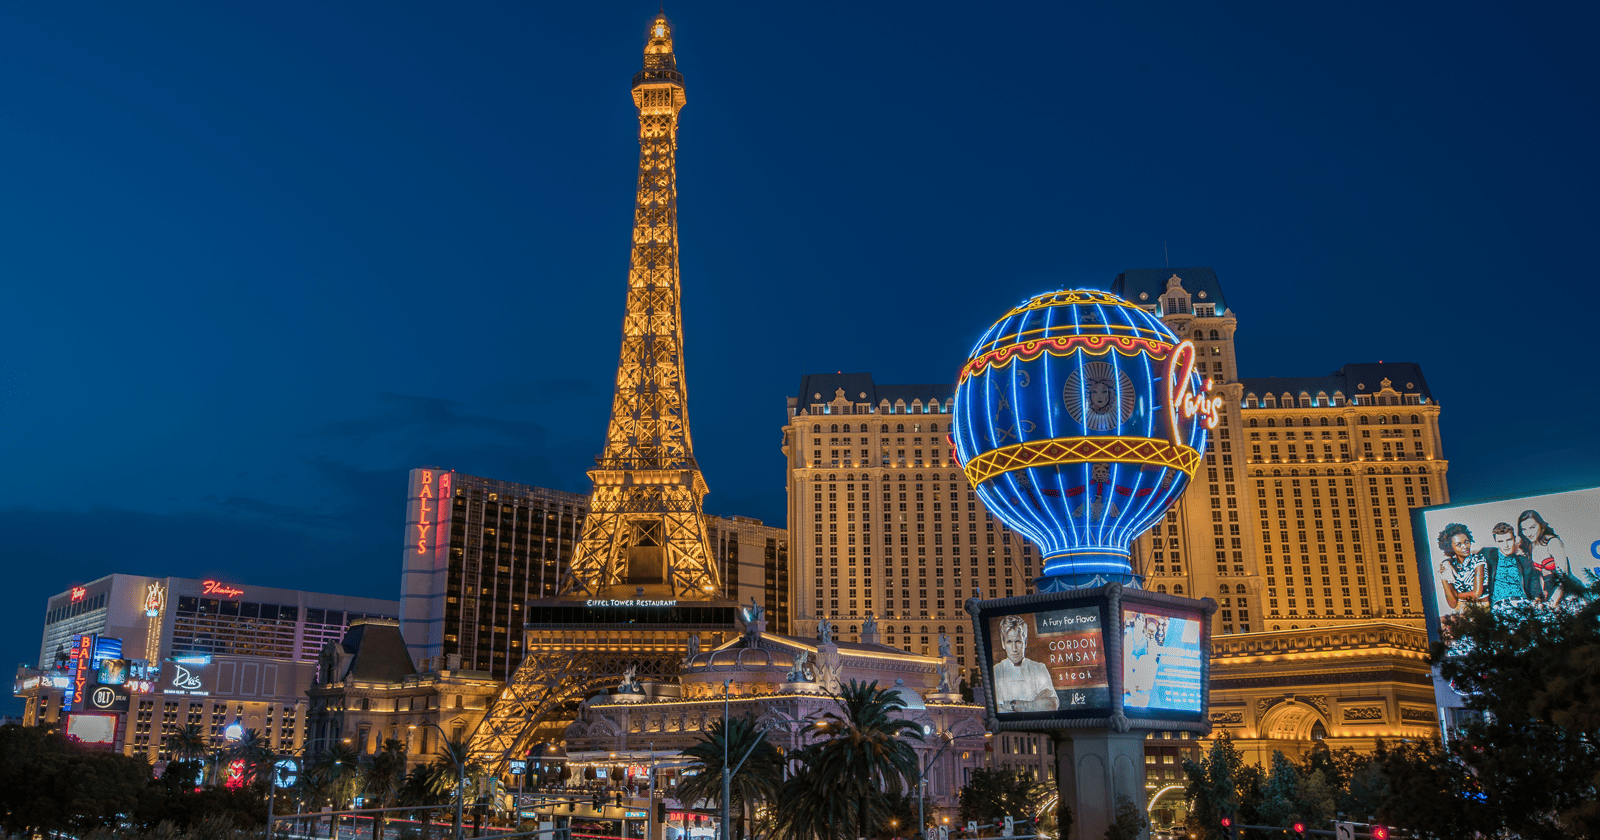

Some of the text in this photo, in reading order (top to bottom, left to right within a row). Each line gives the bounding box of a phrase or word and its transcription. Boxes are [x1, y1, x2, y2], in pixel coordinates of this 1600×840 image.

[1168, 340, 1222, 446] Paris
[417, 470, 432, 555] BALLYS
[203, 580, 243, 598] Flamingo
[1049, 618, 1062, 626] Fury
[1064, 616, 1074, 624] For
[1076, 615, 1096, 624] Flavor
[1049, 638, 1097, 651] GORDON
[1050, 651, 1097, 663] RAMSAY
[74, 636, 91, 703] BALLYS
[1059, 670, 1092, 680] steak
[97, 691, 110, 704] BLT
